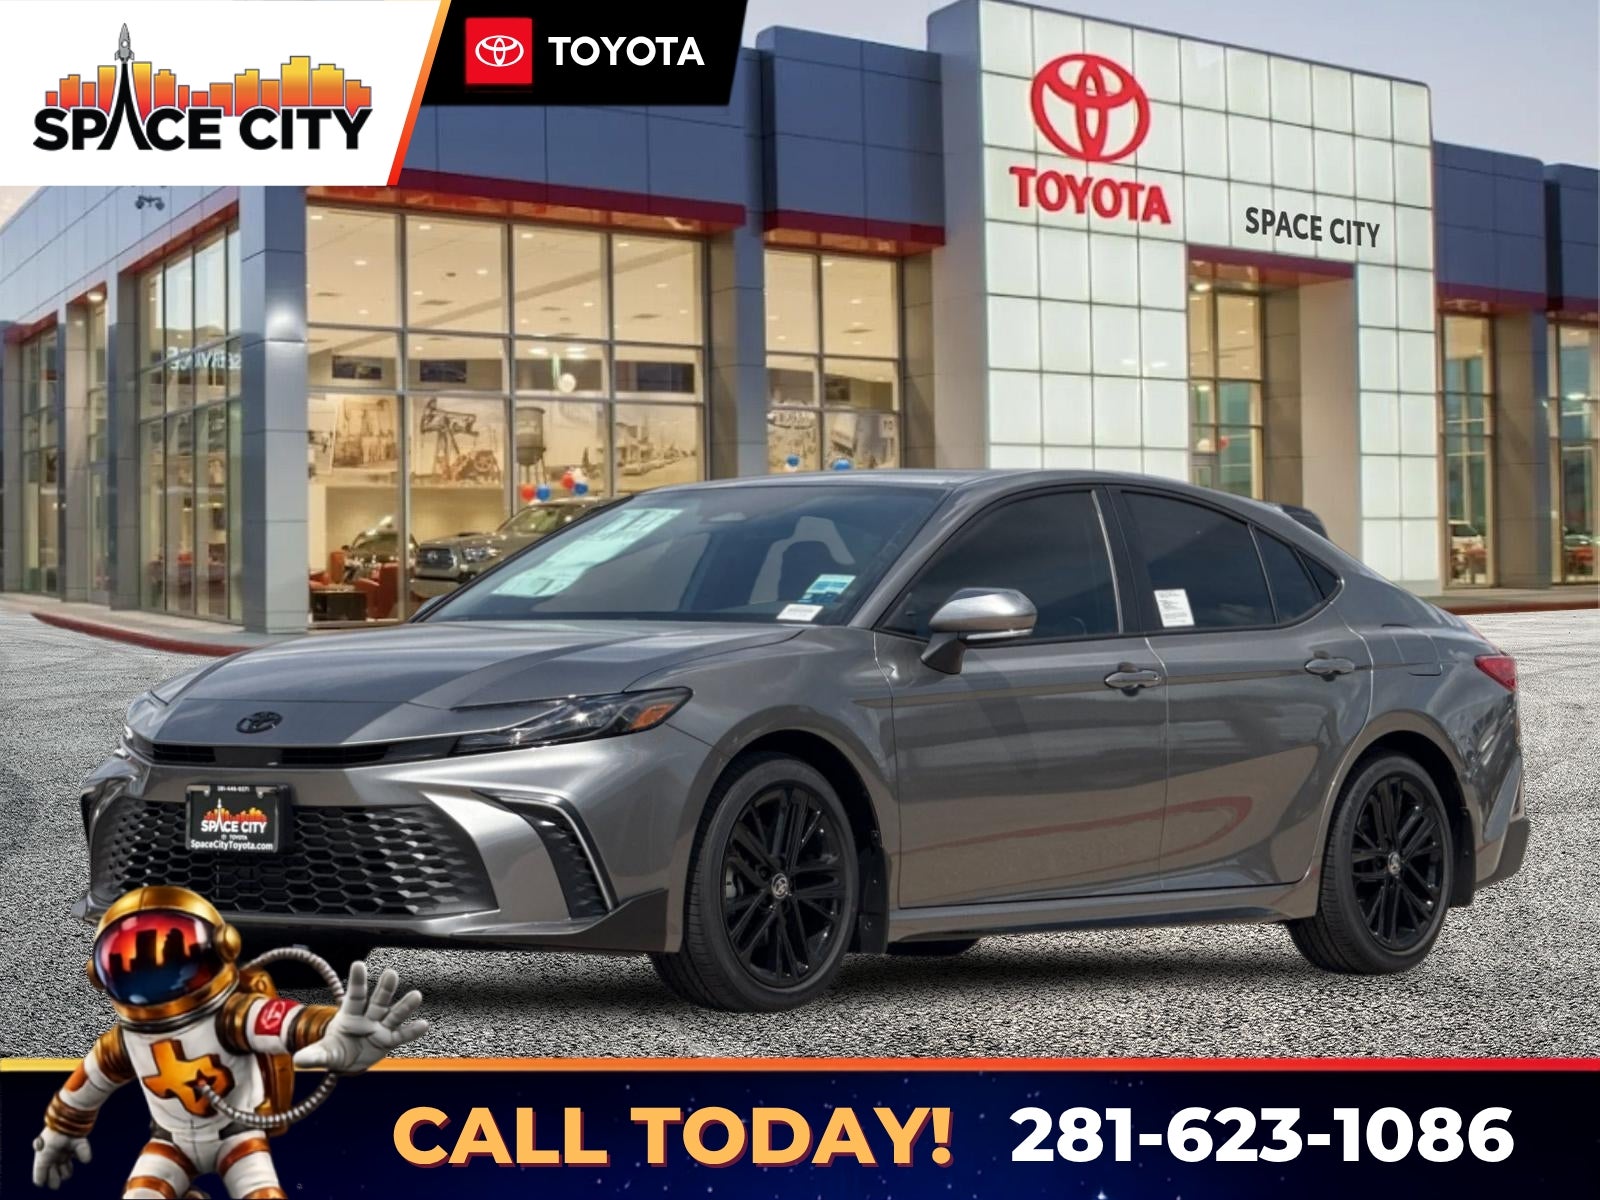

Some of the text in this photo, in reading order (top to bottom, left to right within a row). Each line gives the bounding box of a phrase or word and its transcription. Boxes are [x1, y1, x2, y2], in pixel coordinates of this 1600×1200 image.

[1009, 166, 1171, 224] TOYOTA
[1244, 207, 1381, 248] SPACE CITY
[201, 820, 267, 834] SPACE CITY
[190, 839, 274, 851] SpaceCityToyota.com
